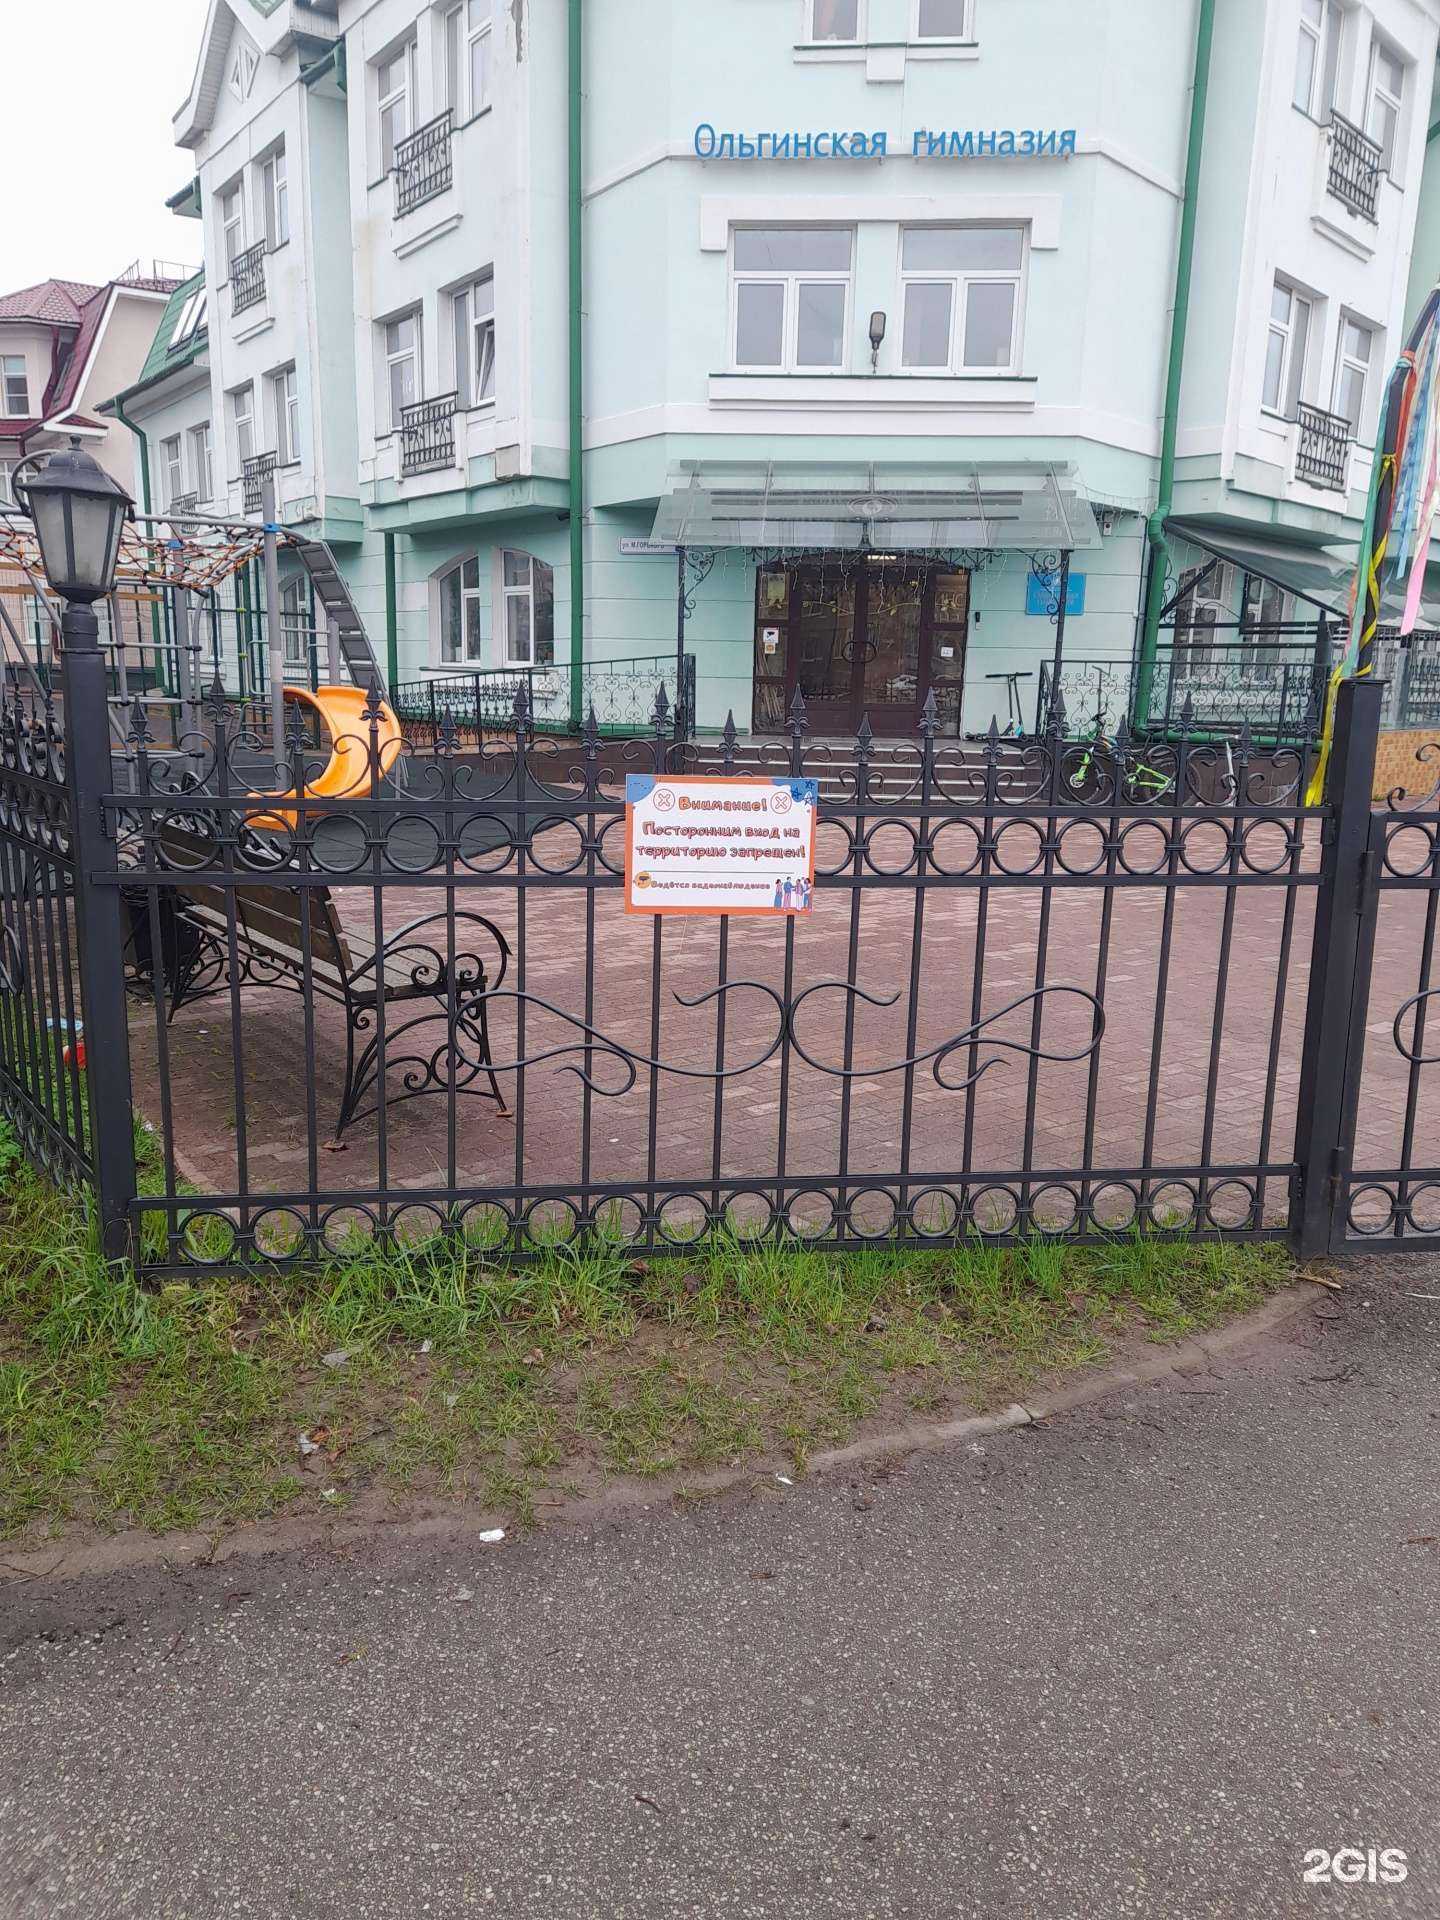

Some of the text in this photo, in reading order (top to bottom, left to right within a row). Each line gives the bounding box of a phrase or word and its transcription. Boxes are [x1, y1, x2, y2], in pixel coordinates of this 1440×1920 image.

[694, 123, 1077, 159] Ольгинская гимназия
[678, 796, 768, 812] Внимание!
[642, 821, 801, 839] Посторонним вход на
[636, 845, 806, 860] территорию запрещен!
